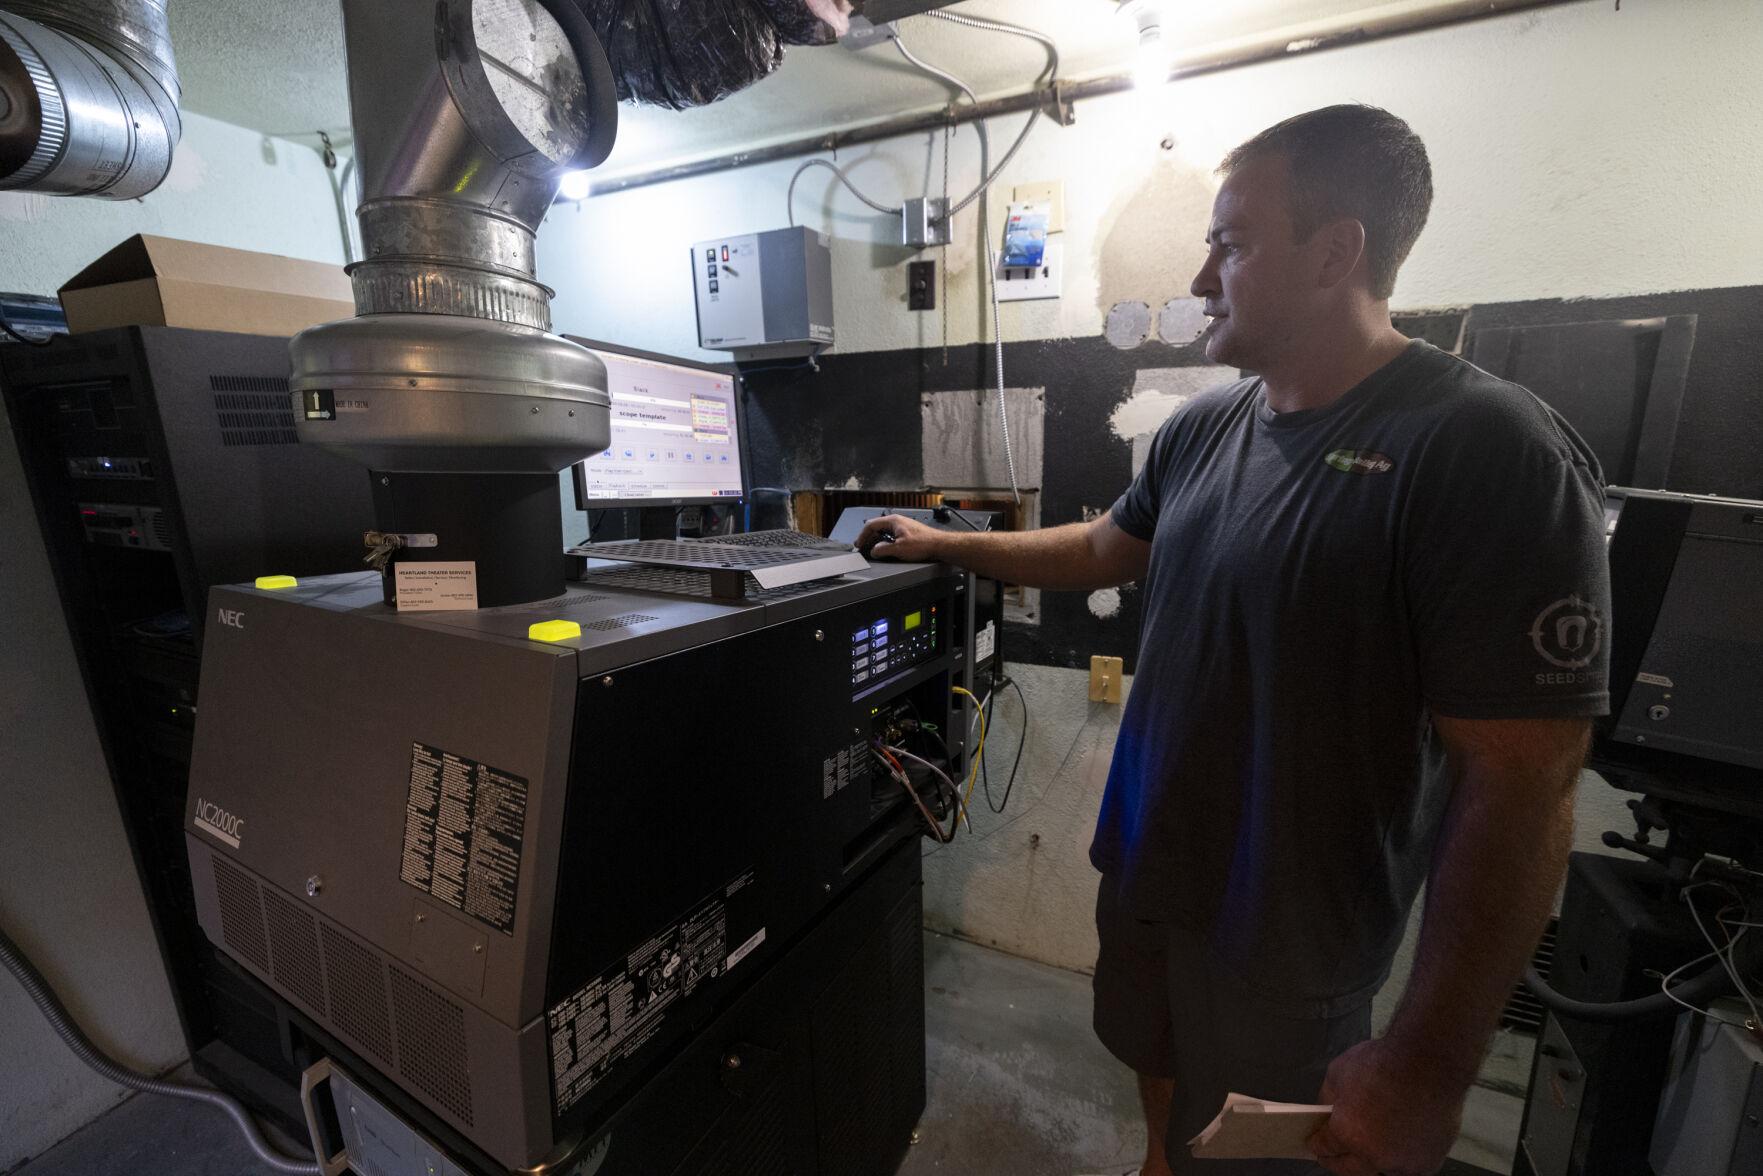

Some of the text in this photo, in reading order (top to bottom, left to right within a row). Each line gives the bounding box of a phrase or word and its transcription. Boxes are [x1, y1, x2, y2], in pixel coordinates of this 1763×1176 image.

[355, 400, 369, 408] CHINA
[619, 411, 667, 421] scope template
[218, 608, 245, 629] NEC
[196, 798, 244, 839] NC2000C
[549, 997, 572, 1017] NEC
